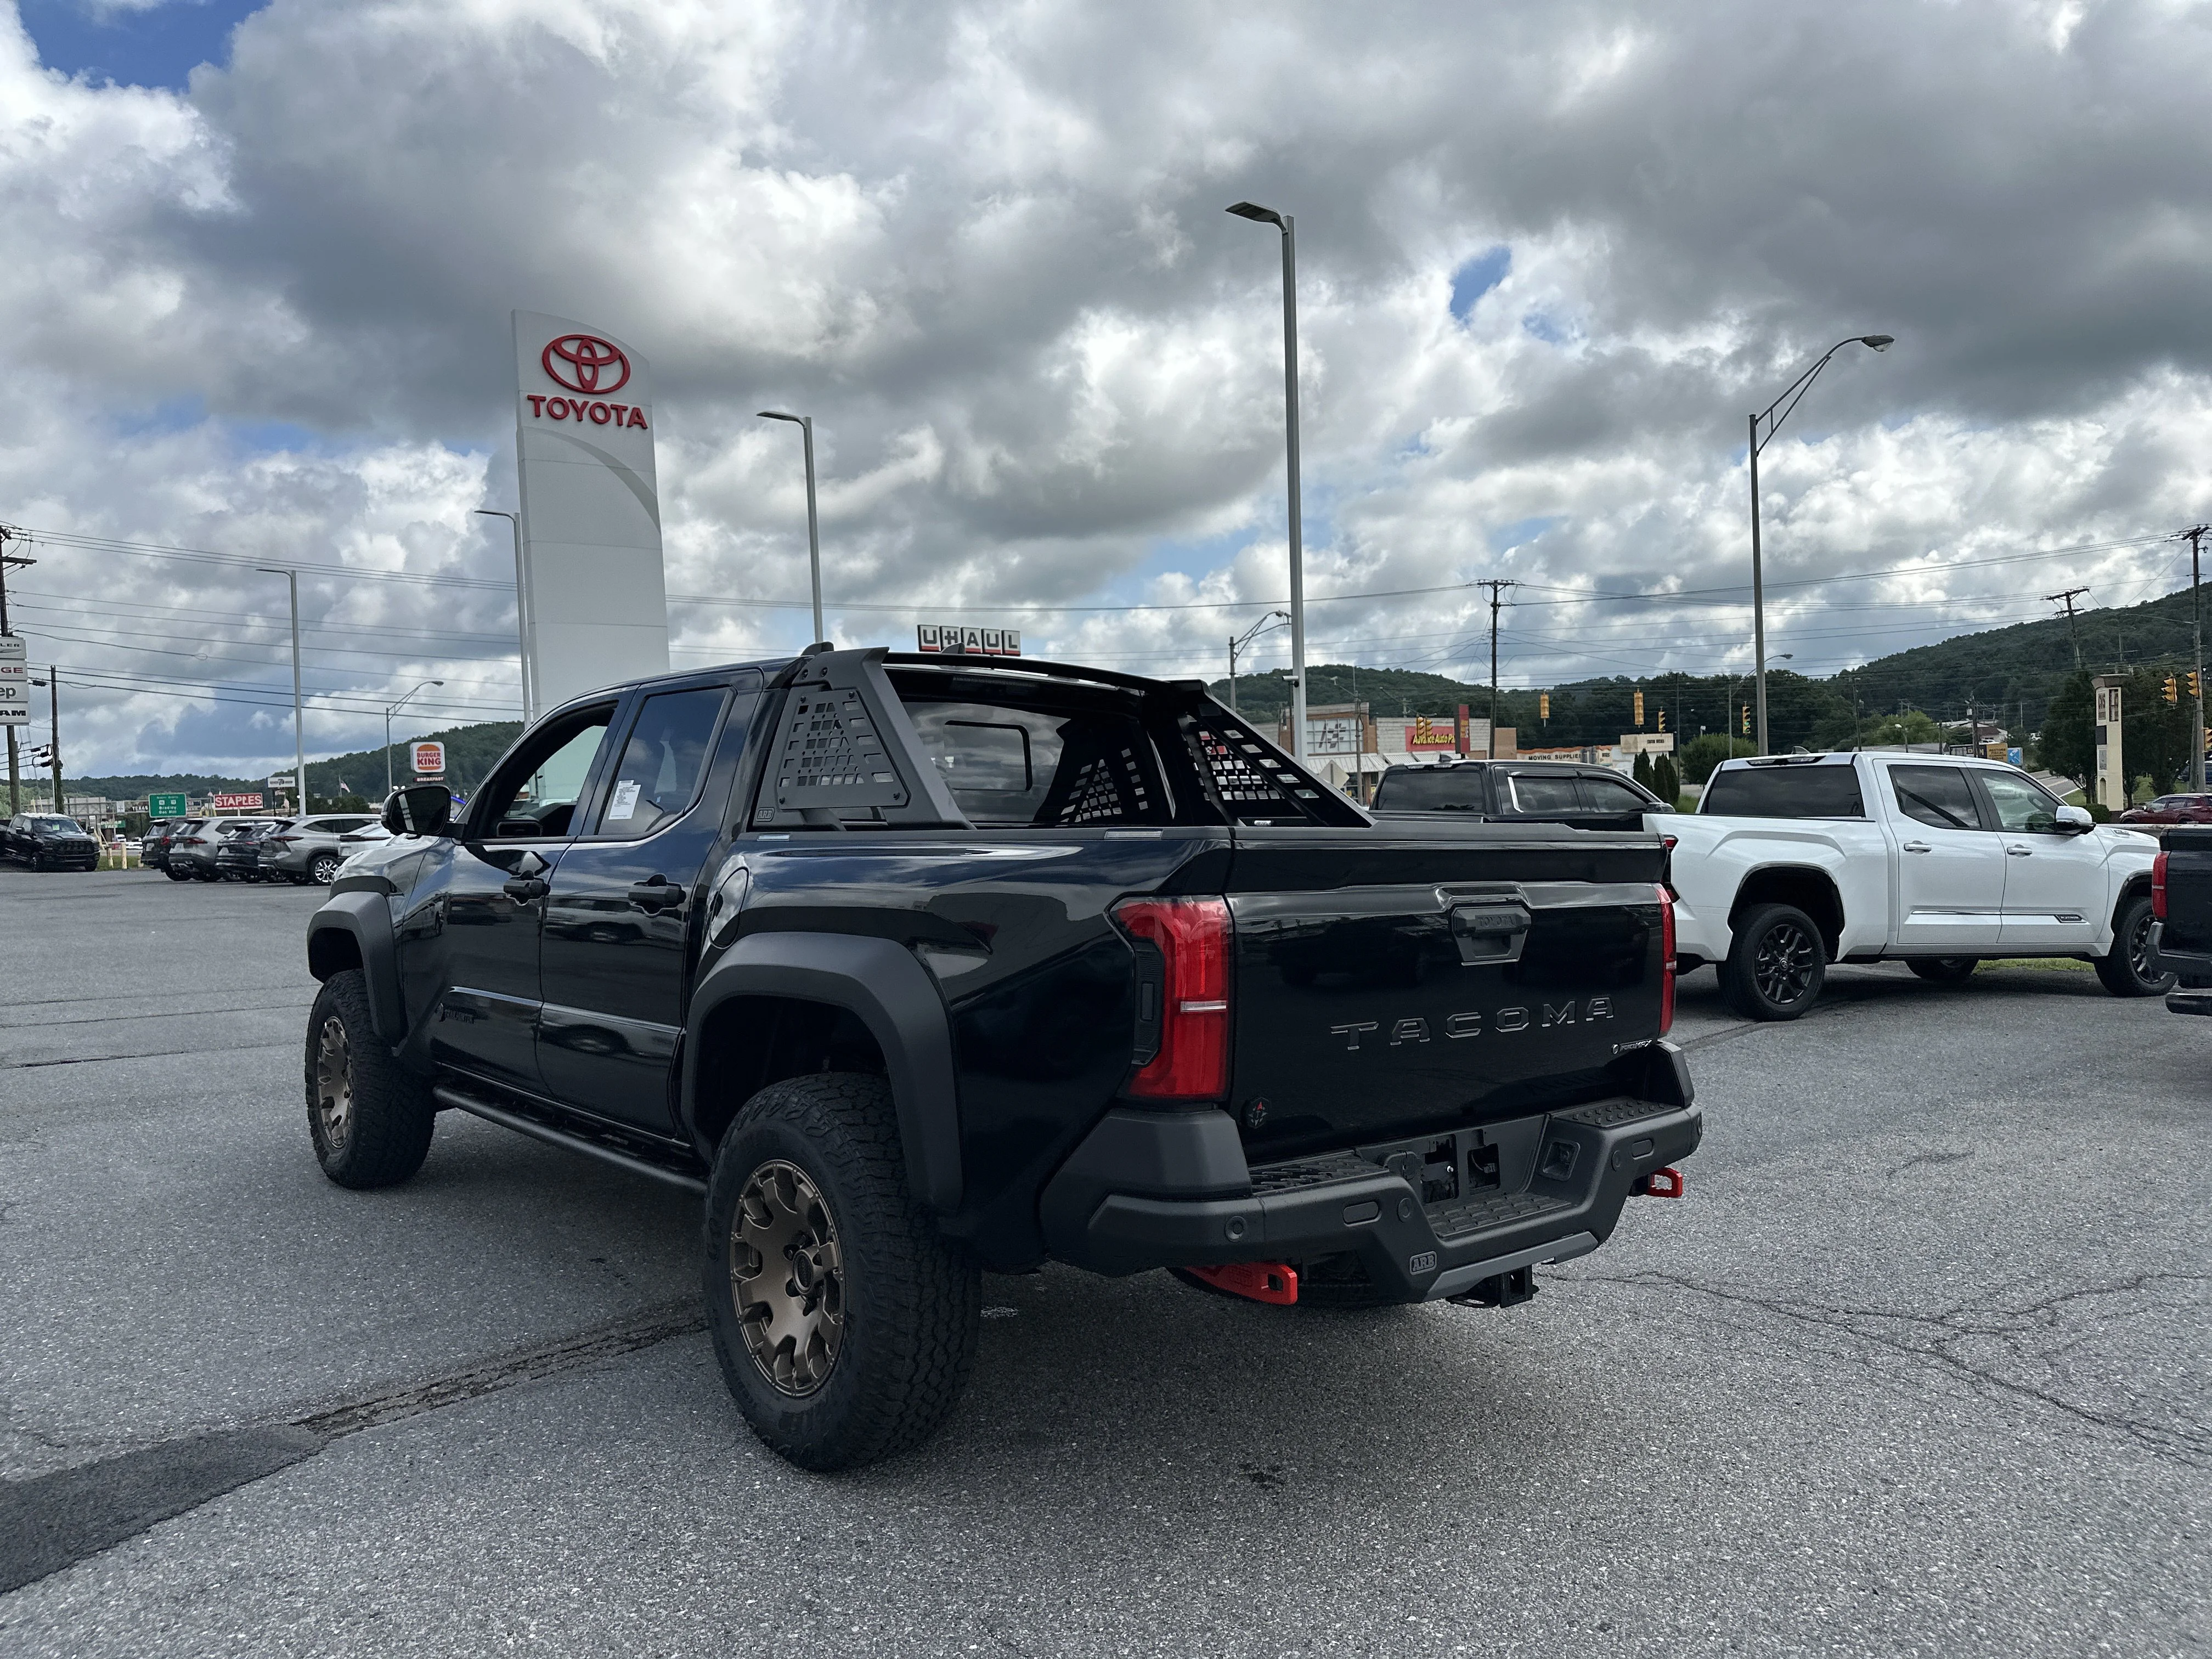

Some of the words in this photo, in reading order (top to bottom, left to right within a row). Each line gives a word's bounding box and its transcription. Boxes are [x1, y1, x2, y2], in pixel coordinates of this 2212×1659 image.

[527, 394, 648, 429] TOYOTA
[1435, 733, 1448, 744] Auto
[215, 795, 262, 807] STAPLES
[757, 810, 772, 819] ARB
[1478, 915, 1516, 927] TOYOTA
[1330, 997, 1615, 1051] TACOMA
[1412, 1255, 1434, 1272] ARB
